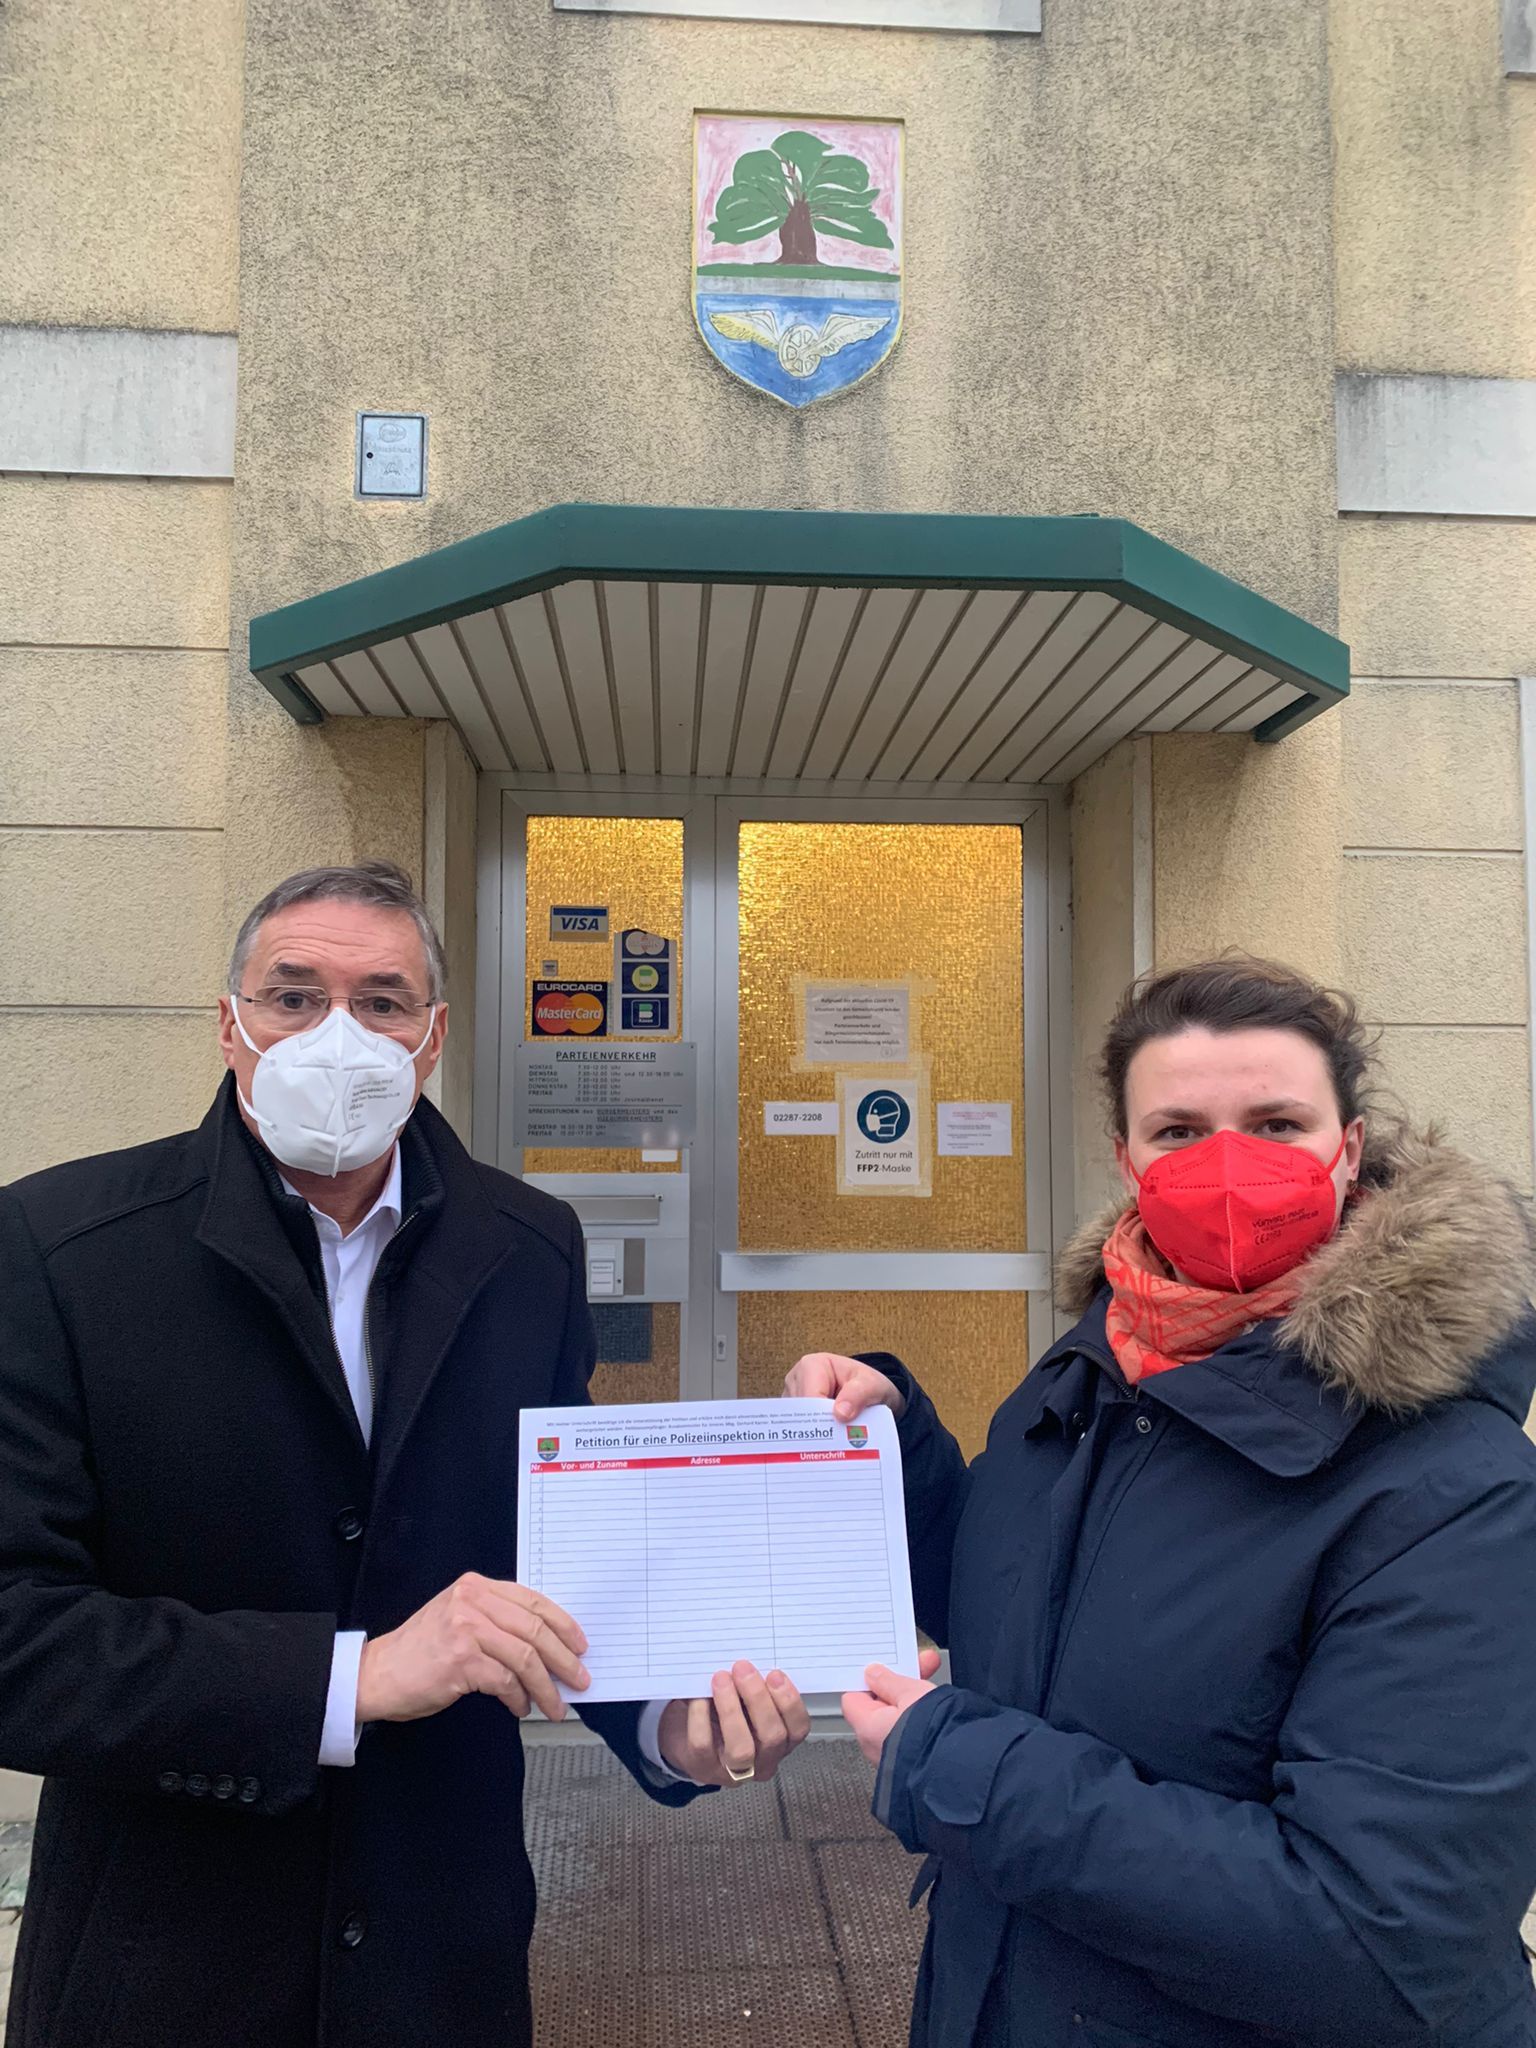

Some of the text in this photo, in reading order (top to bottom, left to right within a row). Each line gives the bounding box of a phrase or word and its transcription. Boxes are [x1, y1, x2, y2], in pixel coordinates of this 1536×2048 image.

[561, 917, 599, 930] VISA
[537, 983, 602, 991] EUROCARD
[537, 1008, 601, 1019] MasterCard
[556, 1051, 657, 1060] PARTEIENVERKEHR
[773, 1113, 823, 1122] 02287-2208
[855, 1150, 881, 1159] Zutritt
[900, 1150, 913, 1159] mit
[857, 1164, 911, 1173] FFP2-Maske
[575, 1427, 834, 1448] Petition für eine Polizeiinspektion in Strasshof
[531, 1451, 846, 1472] Nr. Vor- und Zuname Adresse Unterschrift
